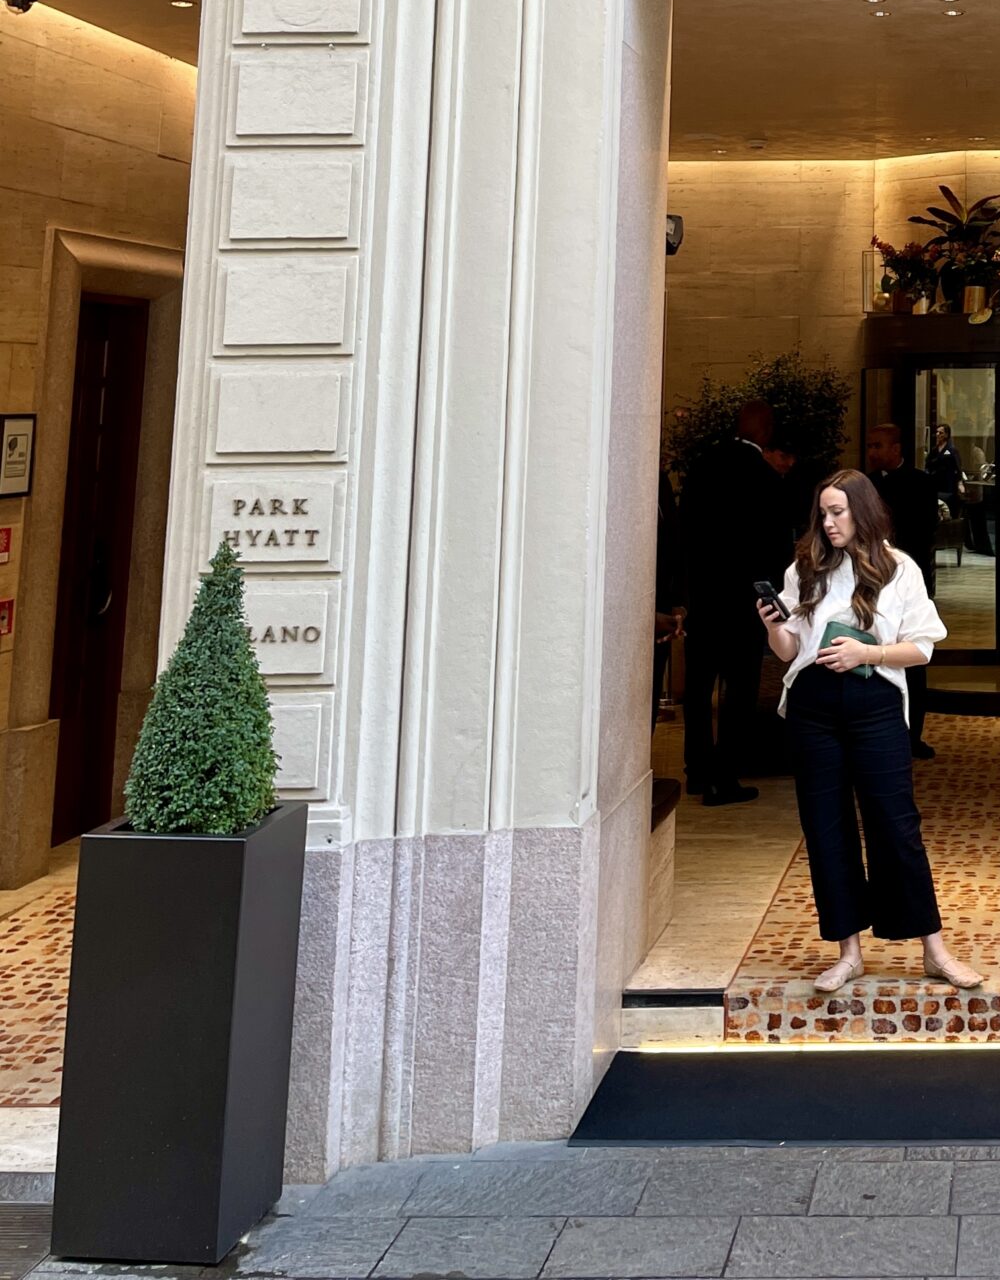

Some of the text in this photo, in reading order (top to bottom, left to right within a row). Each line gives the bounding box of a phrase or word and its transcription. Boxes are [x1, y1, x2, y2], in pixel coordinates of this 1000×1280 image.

[233, 498, 309, 517] PARK
[223, 529, 320, 547] HYATT
[245, 625, 322, 644] LANO
